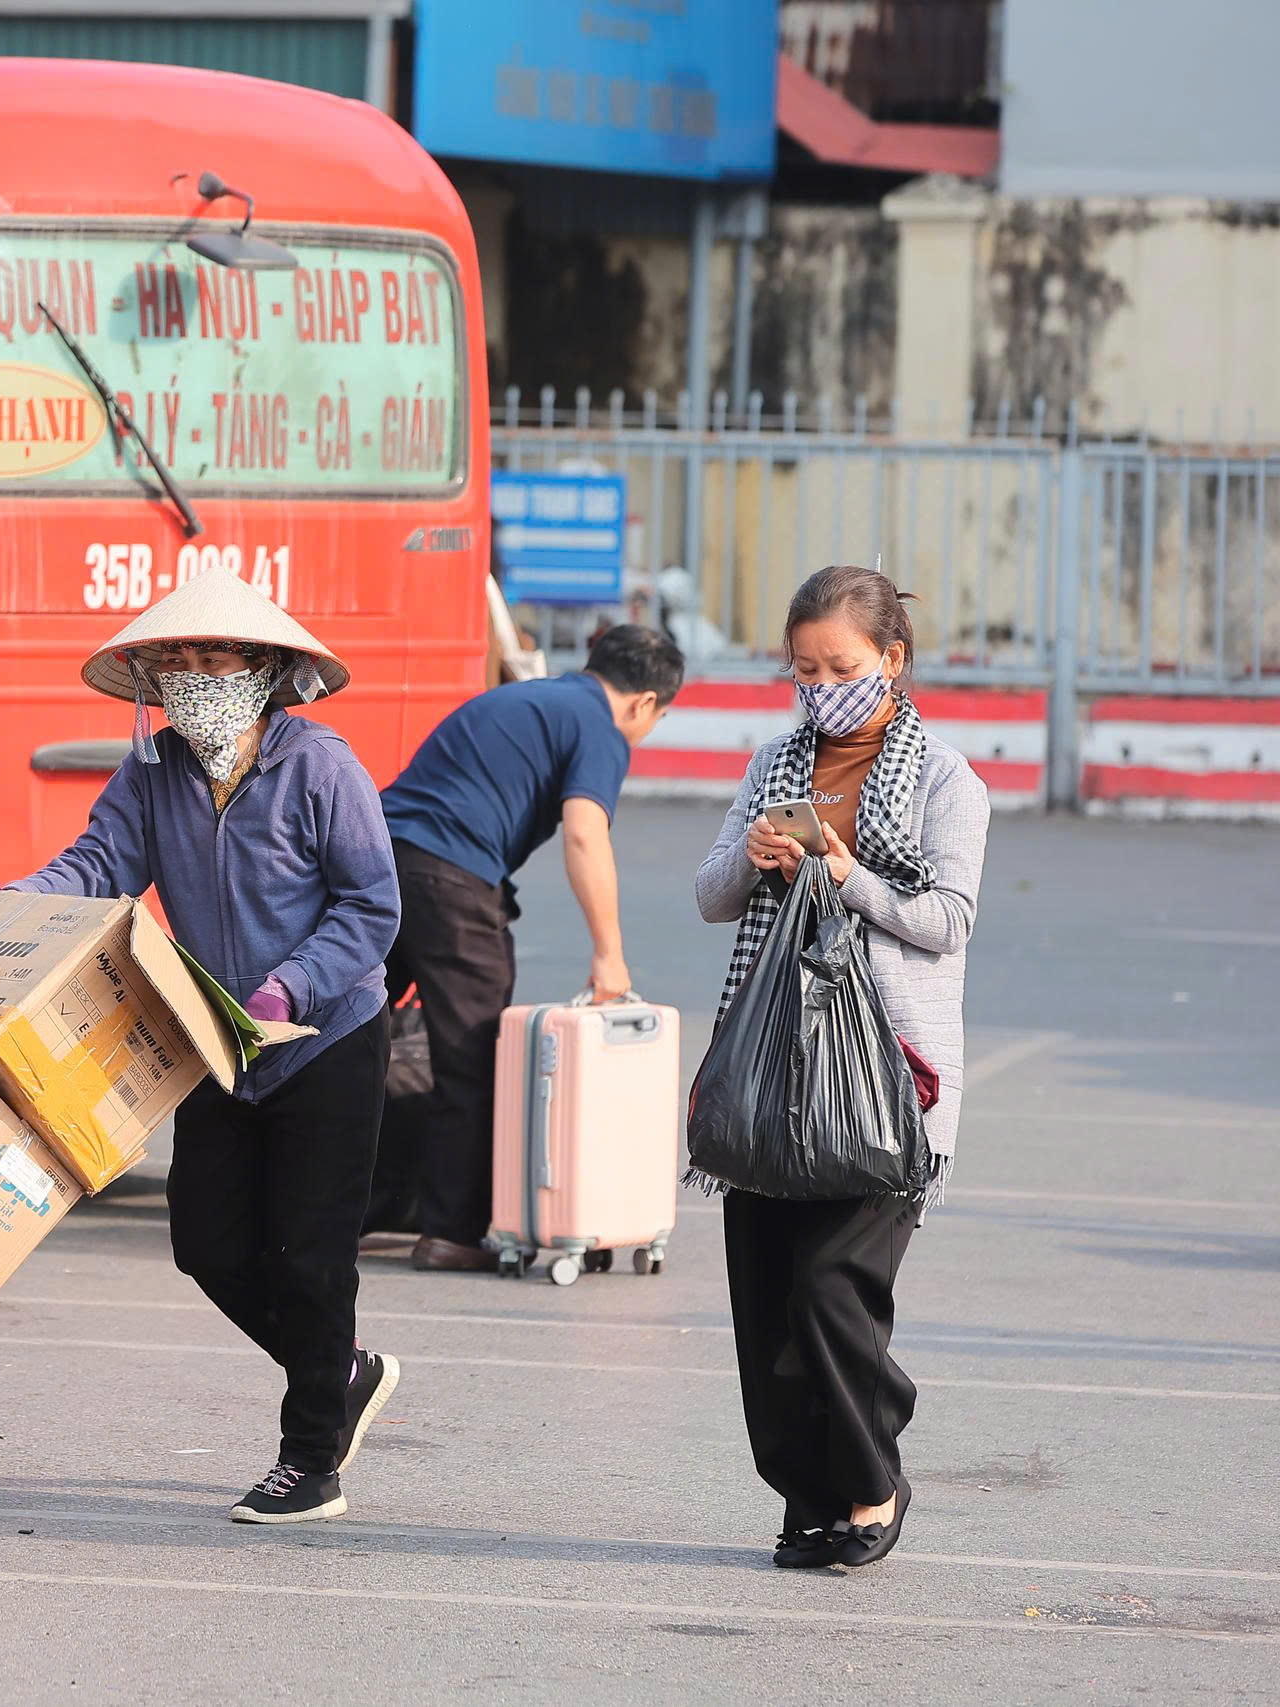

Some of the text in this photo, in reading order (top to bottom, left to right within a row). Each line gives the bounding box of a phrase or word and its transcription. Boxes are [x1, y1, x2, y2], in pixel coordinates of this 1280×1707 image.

[135, 244, 187, 338] HÀ
[294, 250, 370, 343] GIÁP
[381, 253, 442, 344] BÁT
[316, 380, 351, 470] CÀ
[381, 381, 447, 471] GIÁN
[83, 543, 290, 609] 35B-041
[811, 790, 844, 804] Dior
[70, 981, 90, 1006] CHECK
[96, 952, 121, 986] MyJae
[153, 1045, 174, 1070] Foil
[92, 1011, 104, 1025] ITE
[128, 1065, 152, 1095] BARCODE
